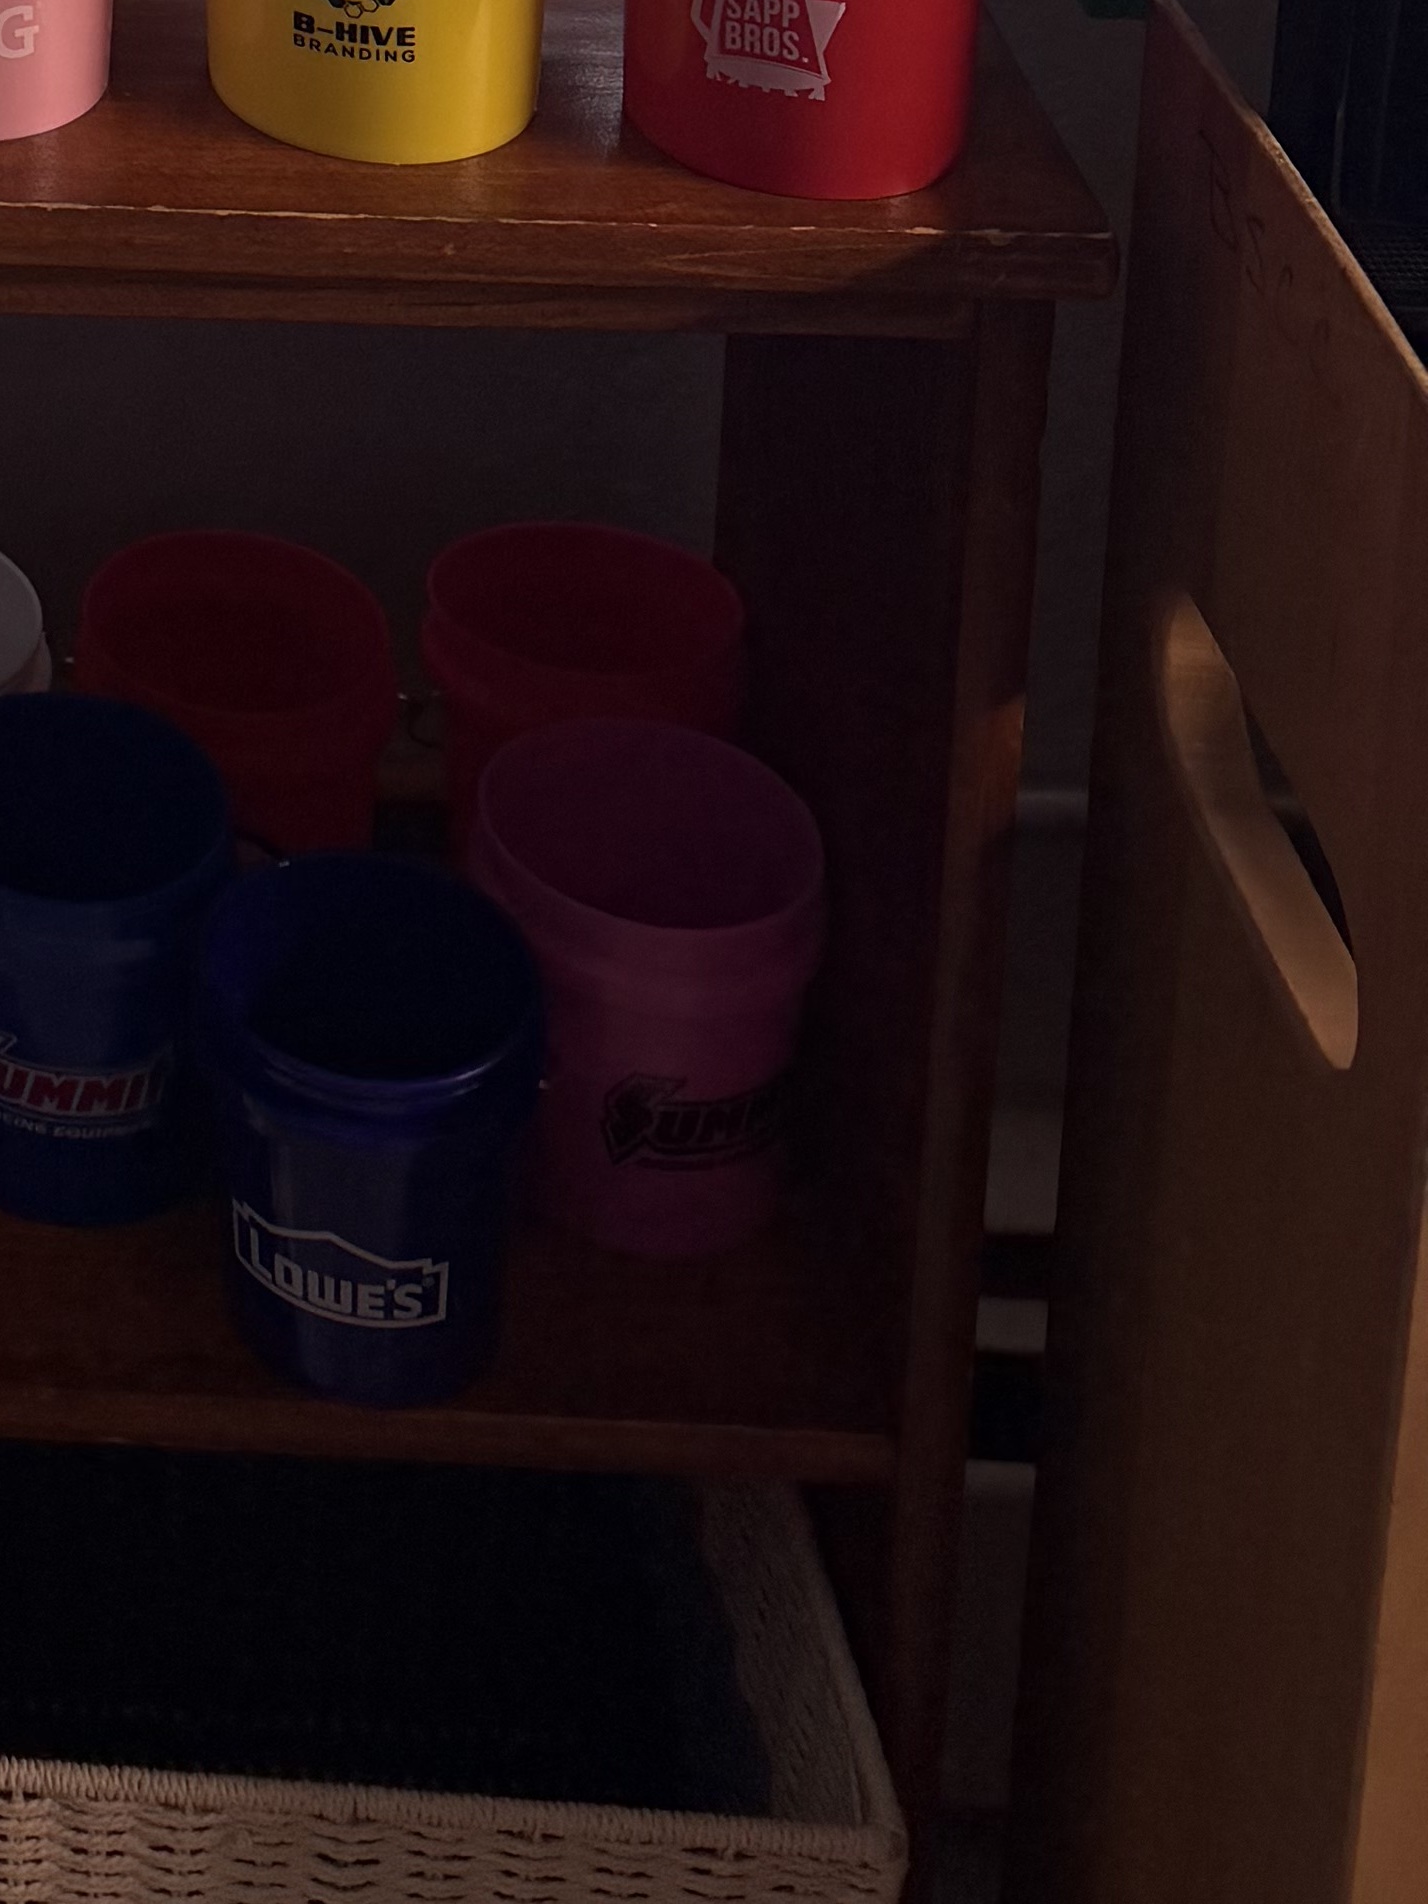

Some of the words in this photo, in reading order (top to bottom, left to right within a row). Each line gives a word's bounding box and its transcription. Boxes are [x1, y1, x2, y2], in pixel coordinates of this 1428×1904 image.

[292, 10, 416, 47] B-HIVE
[292, 34, 416, 63] BRANDING
[724, 19, 809, 64] BROS.
[249, 1227, 424, 1319] LOWE'S
